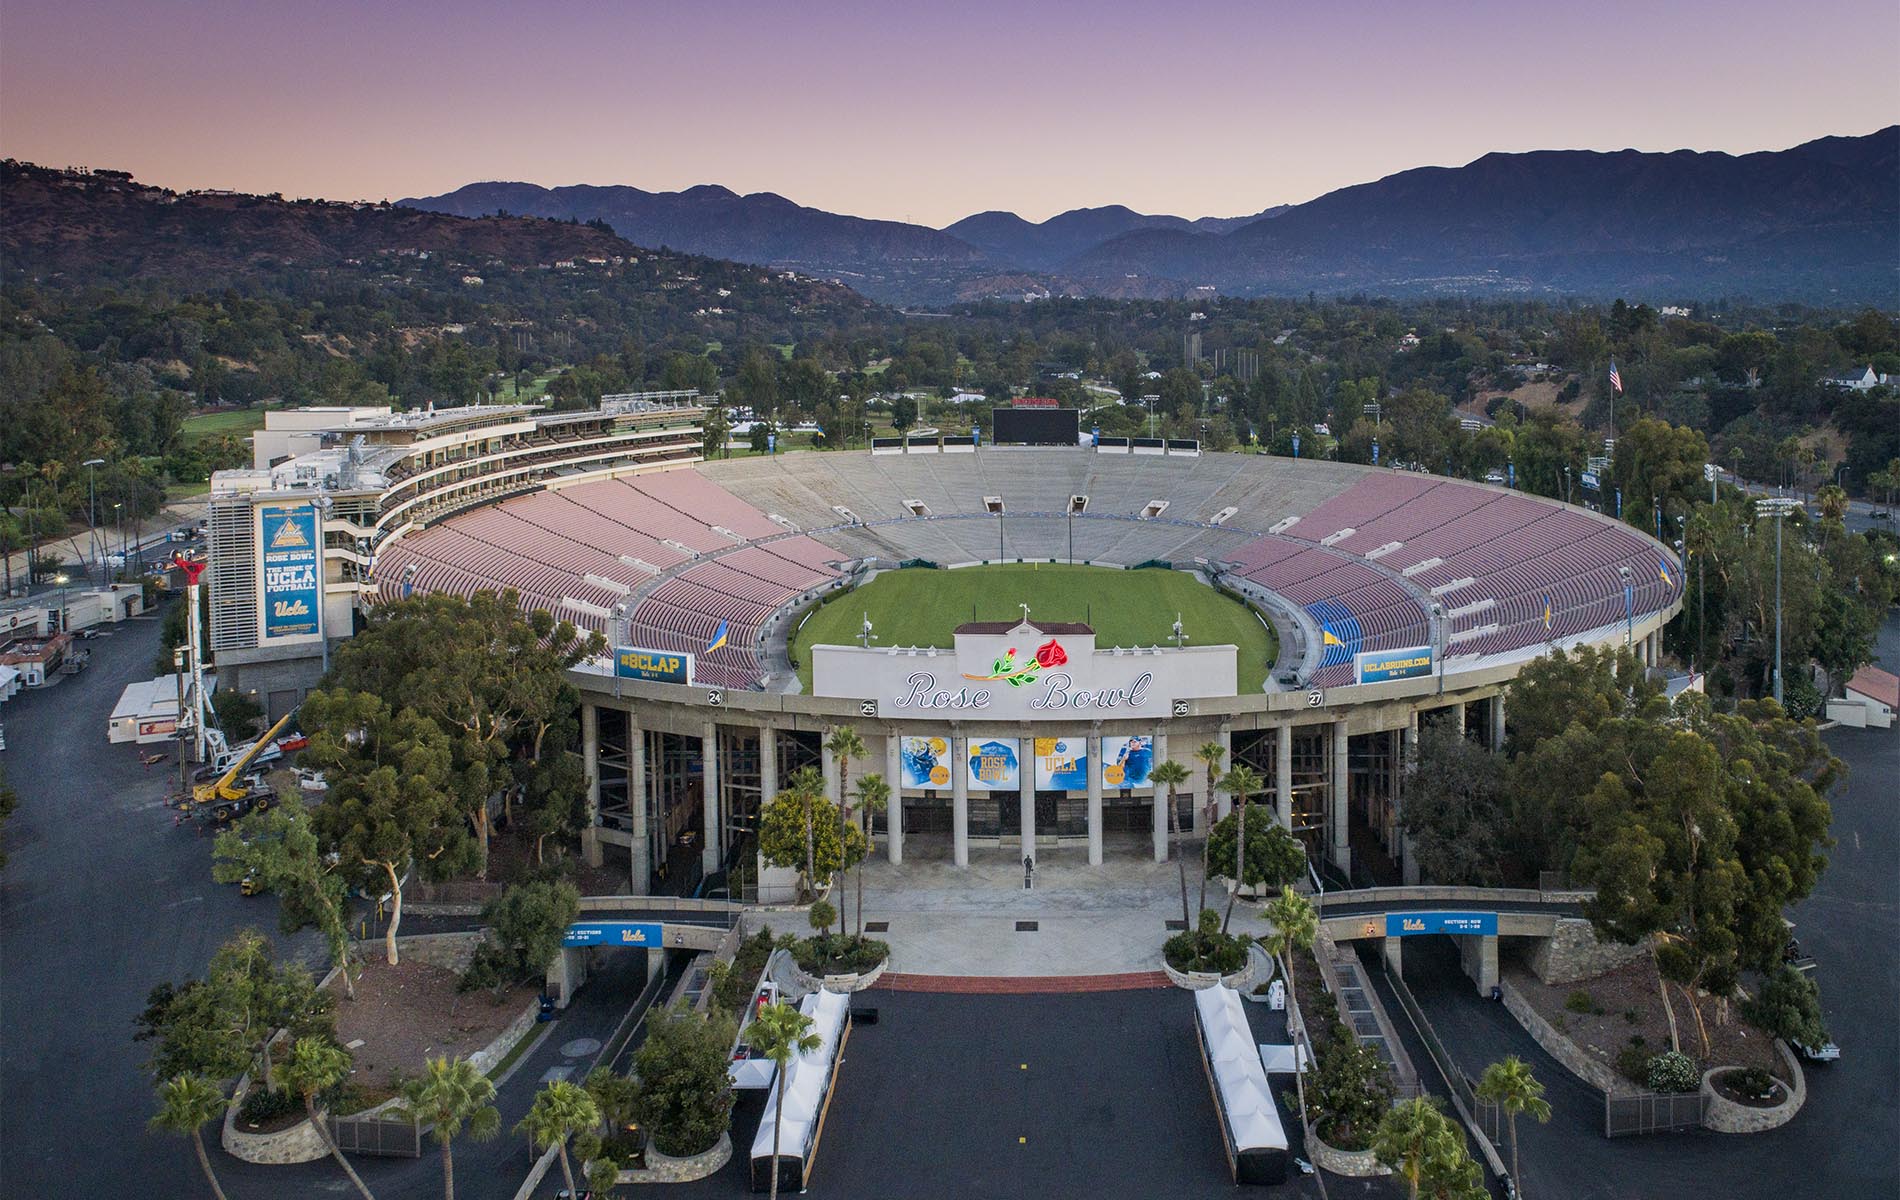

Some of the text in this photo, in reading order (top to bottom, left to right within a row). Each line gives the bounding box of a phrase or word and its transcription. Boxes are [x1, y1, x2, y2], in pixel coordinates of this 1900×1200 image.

[266, 554, 288, 562] ROSE
[290, 553, 314, 561] BOWL
[266, 570, 315, 586] UCLA
[266, 582, 315, 593] FOOTBALL
[274, 599, 309, 617] Ucla
[621, 653, 679, 674] #8CLAP
[1364, 656, 1430, 673] UCLABRUINS.COM
[895, 671, 1154, 710] Rose Bowl
[708, 693, 721, 703] 24
[1309, 694, 1321, 704] 27
[862, 703, 875, 713] 25
[1174, 704, 1188, 714] 26
[981, 756, 1006, 769] ROSE
[1045, 757, 1077, 772] UCLA
[979, 768, 1008, 781] BOWL
[1402, 918, 1425, 931] Ucla
[621, 929, 646, 942] Ucla
